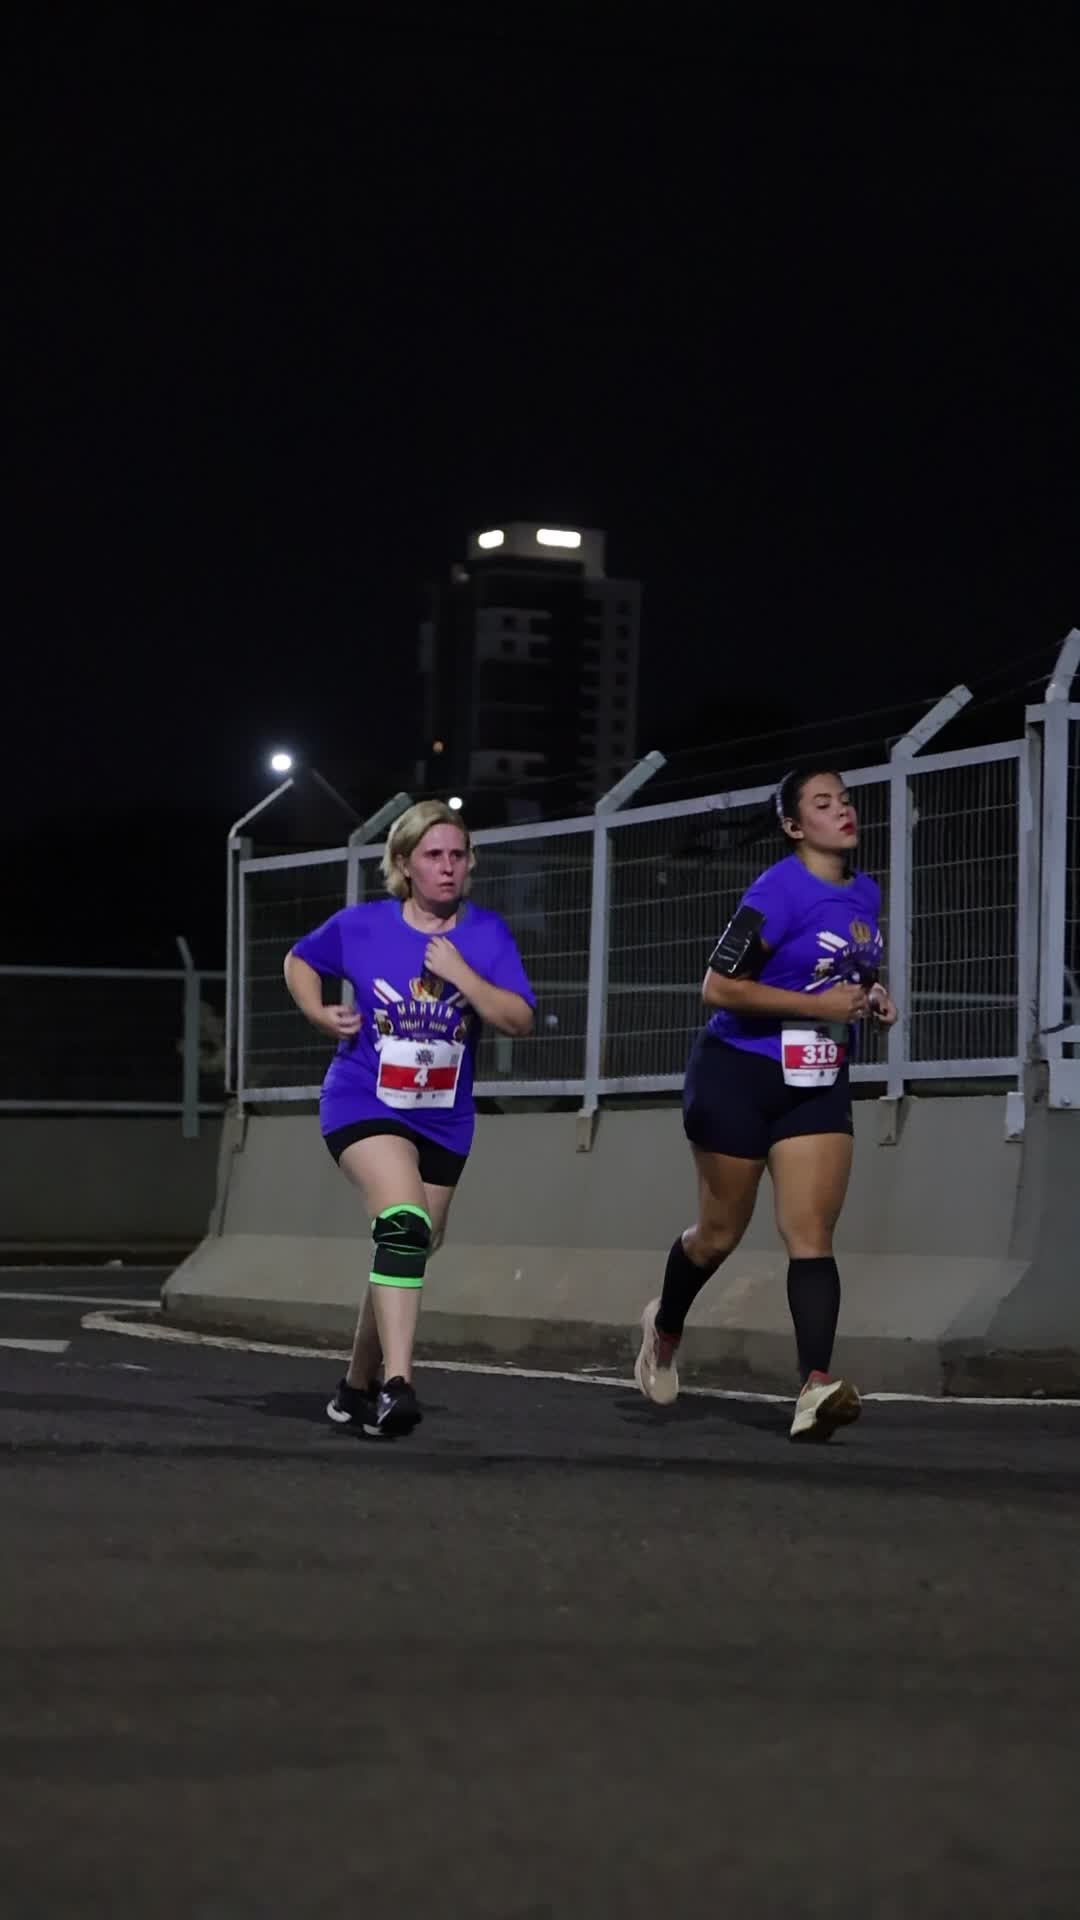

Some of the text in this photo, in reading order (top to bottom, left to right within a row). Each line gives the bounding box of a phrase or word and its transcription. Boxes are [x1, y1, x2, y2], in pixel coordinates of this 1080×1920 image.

[397, 1001, 454, 1019] MARVIN
[399, 1018, 448, 1033] NIGHT RUN
[802, 1045, 838, 1064] 319
[414, 1067, 429, 1086] 4
